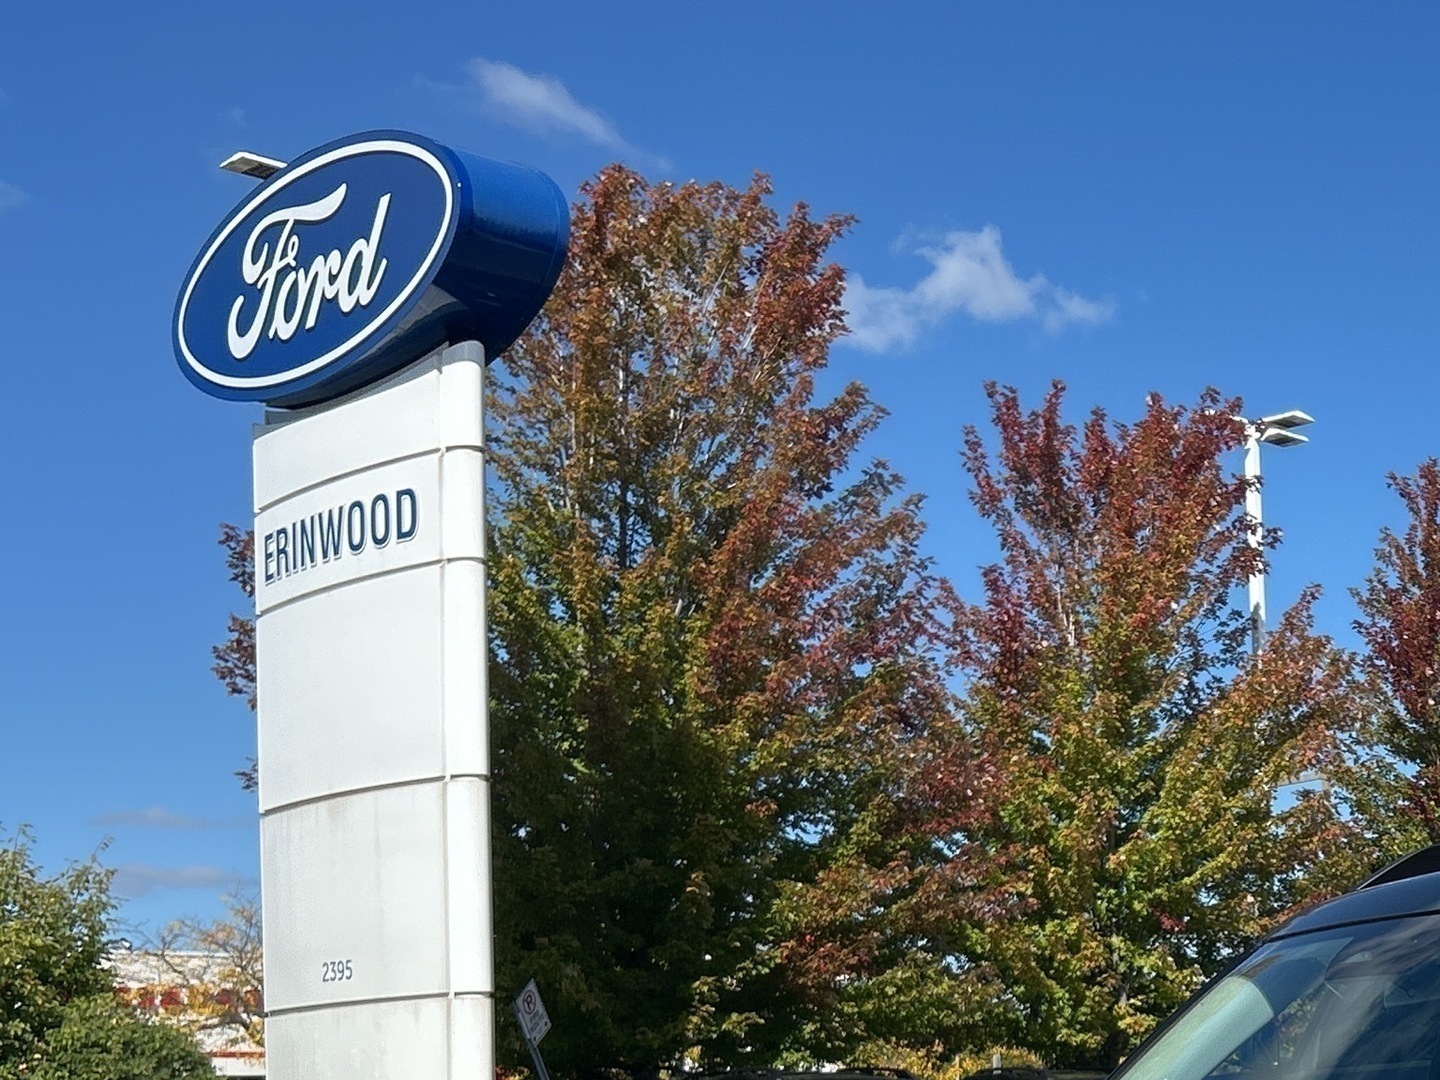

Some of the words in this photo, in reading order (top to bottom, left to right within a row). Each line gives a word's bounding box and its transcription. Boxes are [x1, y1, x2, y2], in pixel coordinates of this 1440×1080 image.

[227, 182, 392, 360] Ford
[263, 487, 420, 583] ERINWOOD
[322, 959, 353, 983] 2395
